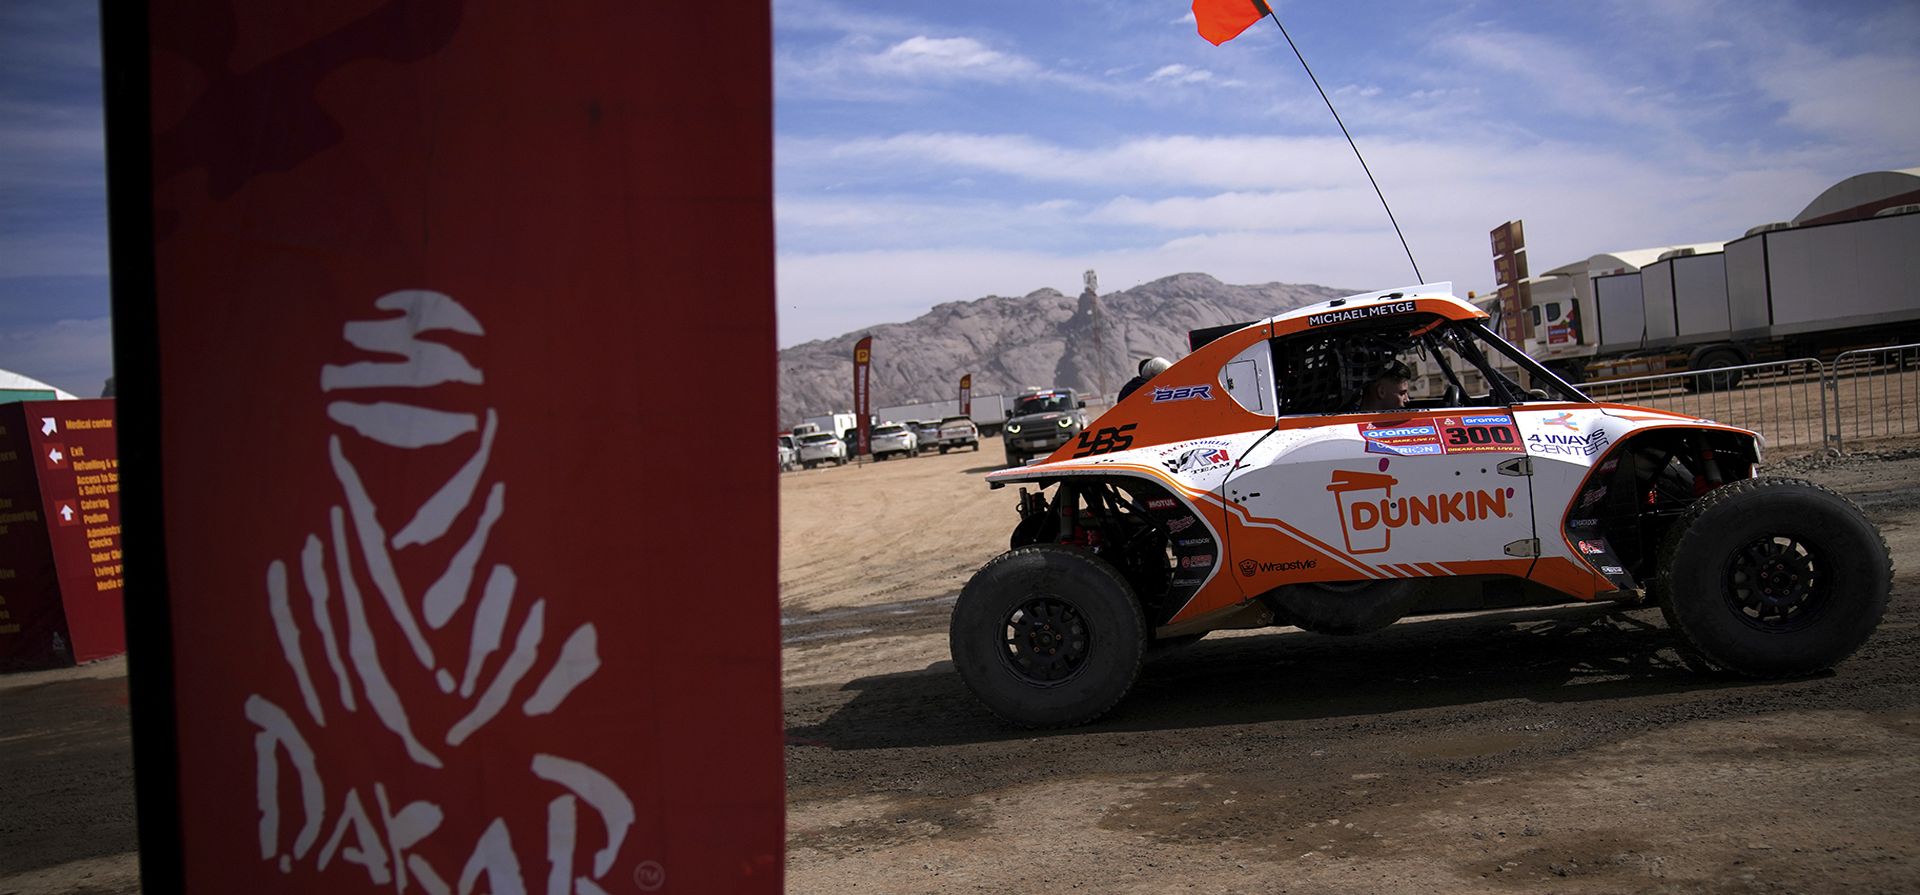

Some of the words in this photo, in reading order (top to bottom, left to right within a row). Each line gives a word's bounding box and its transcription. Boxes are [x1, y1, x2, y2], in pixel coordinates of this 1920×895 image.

[1309, 309, 1367, 326] MICHAEL
[1369, 301, 1414, 317] METGE
[1155, 385, 1211, 401] BBR
[65, 418, 91, 430] Medical
[1367, 427, 1430, 438] aramco
[1446, 426, 1514, 445] 300
[1528, 434, 1542, 442] 4
[1545, 428, 1605, 446] WAYS
[70, 446, 84, 457] Exit
[1530, 437, 1609, 456] CENTER
[1190, 462, 1230, 474] TEAM
[76, 474, 101, 486] Access
[100, 473, 108, 483] to
[84, 484, 106, 496] Safety
[80, 498, 110, 510] Catering
[1148, 498, 1175, 508] MOTUL
[83, 513, 108, 524] Podium
[88, 537, 113, 549] checks
[91, 551, 110, 564] Dakar
[94, 566, 115, 578] Living
[1258, 560, 1317, 572] Wrapstyle
[96, 580, 118, 592] Media
[245, 694, 635, 895] DAKAR
